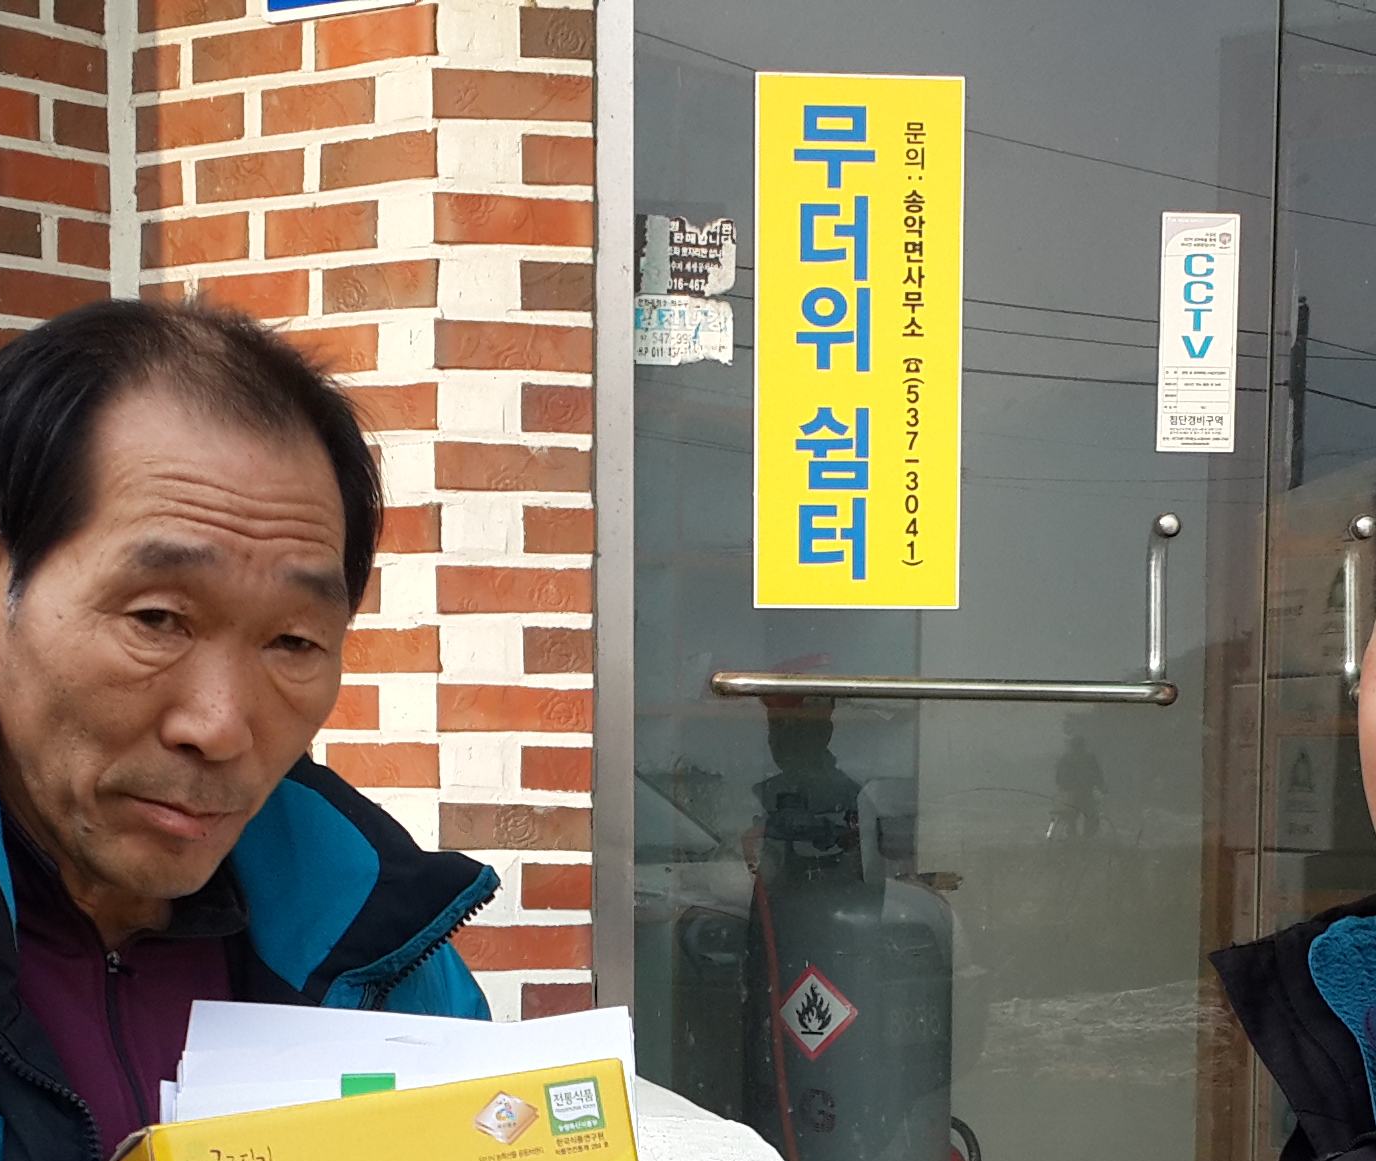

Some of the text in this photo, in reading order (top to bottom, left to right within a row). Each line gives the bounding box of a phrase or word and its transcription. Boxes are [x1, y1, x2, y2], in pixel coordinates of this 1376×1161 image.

[901, 188, 926, 338] 송악면사무소
[1183, 253, 1215, 359] CCTV
[793, 104, 876, 581] 무더위 쉼터
